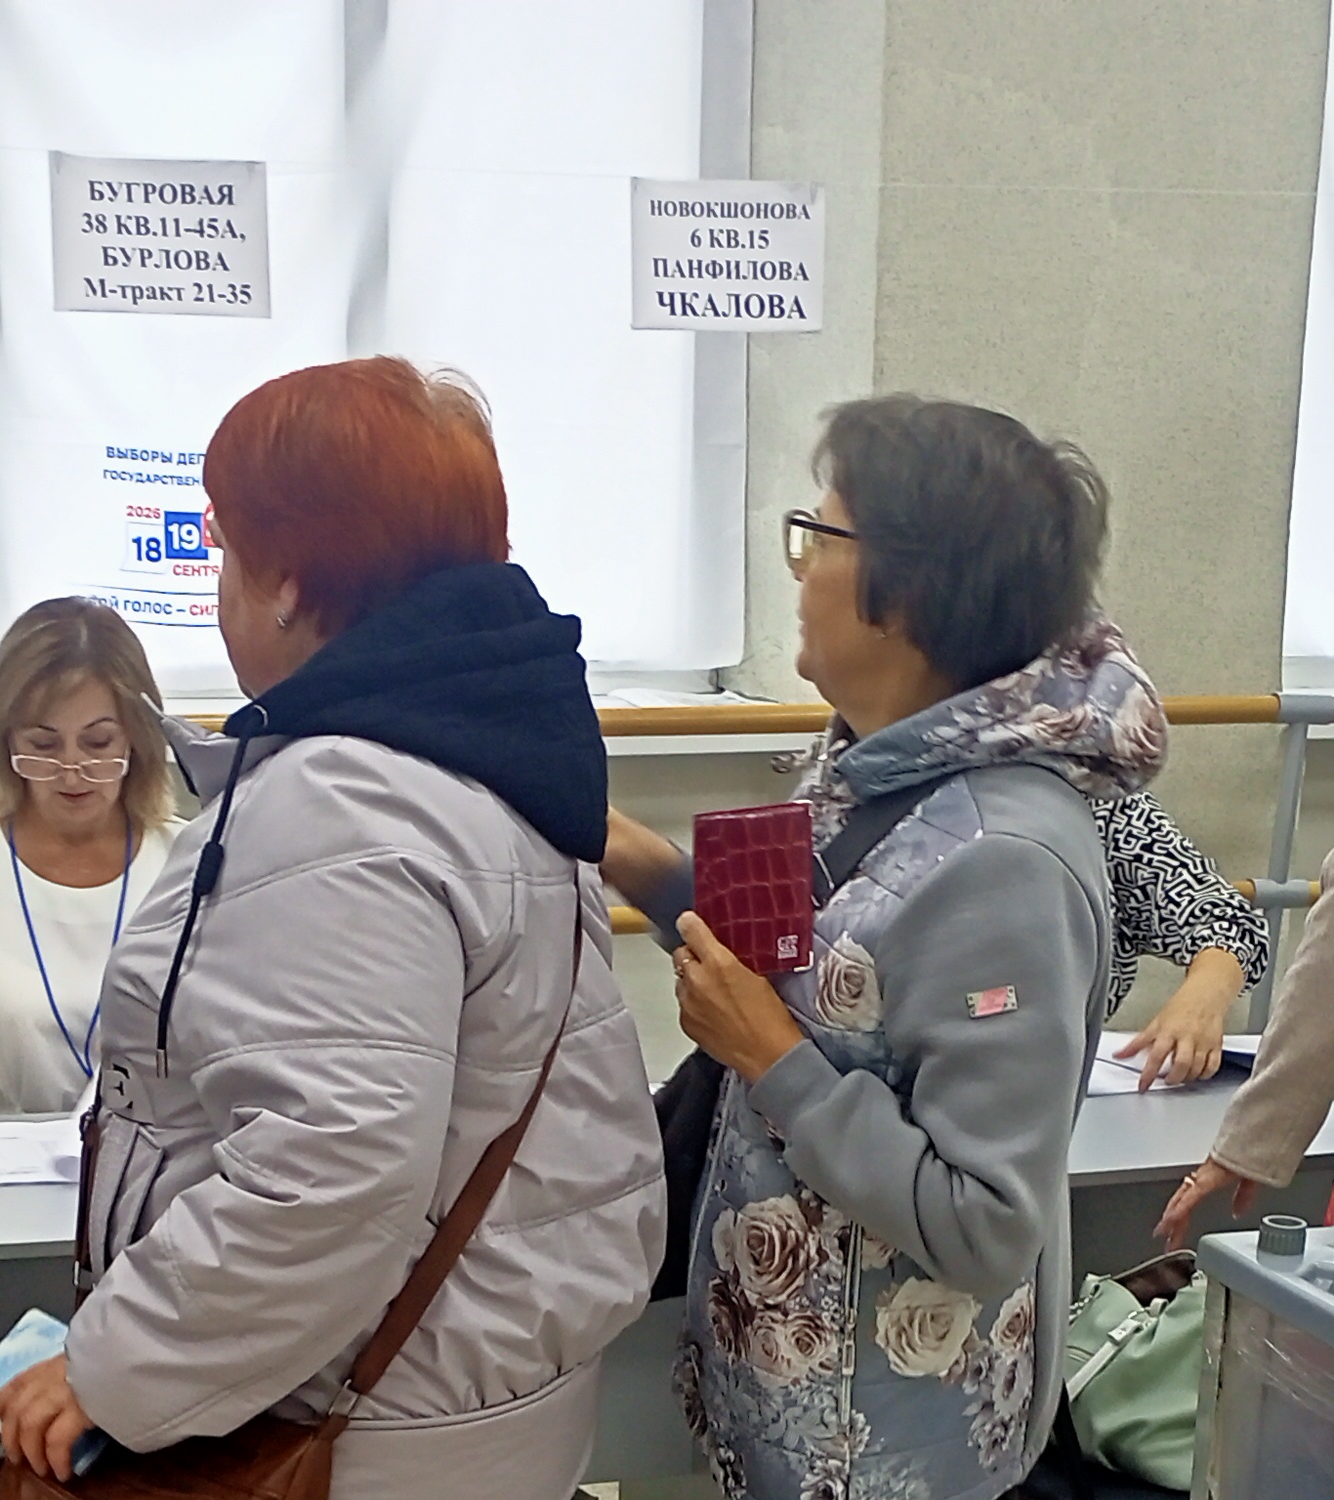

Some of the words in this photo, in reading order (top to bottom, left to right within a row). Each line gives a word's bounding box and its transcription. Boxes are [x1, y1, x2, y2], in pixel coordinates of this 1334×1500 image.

[88, 180, 235, 205] БУГРОВАЯ
[650, 199, 811, 220] НОВОКШОНОВА
[81, 213, 108, 234] 38
[115, 214, 246, 243] КВ.11-45А,
[690, 228, 702, 248] 6
[709, 228, 770, 249] КВ.15
[102, 246, 230, 271] БУРЛОВА
[652, 258, 809, 281] ПАНФИЛОВА
[83, 277, 185, 305] М-тракт
[192, 282, 252, 305] 21-35
[656, 291, 807, 319] ЧКАЛОВА
[106, 446, 172, 463] ВЫБОРЫ
[126, 505, 161, 519] 2026
[131, 536, 162, 562] 18
[168, 523, 201, 550] 19
[124, 599, 172, 614] ГОЛОС
